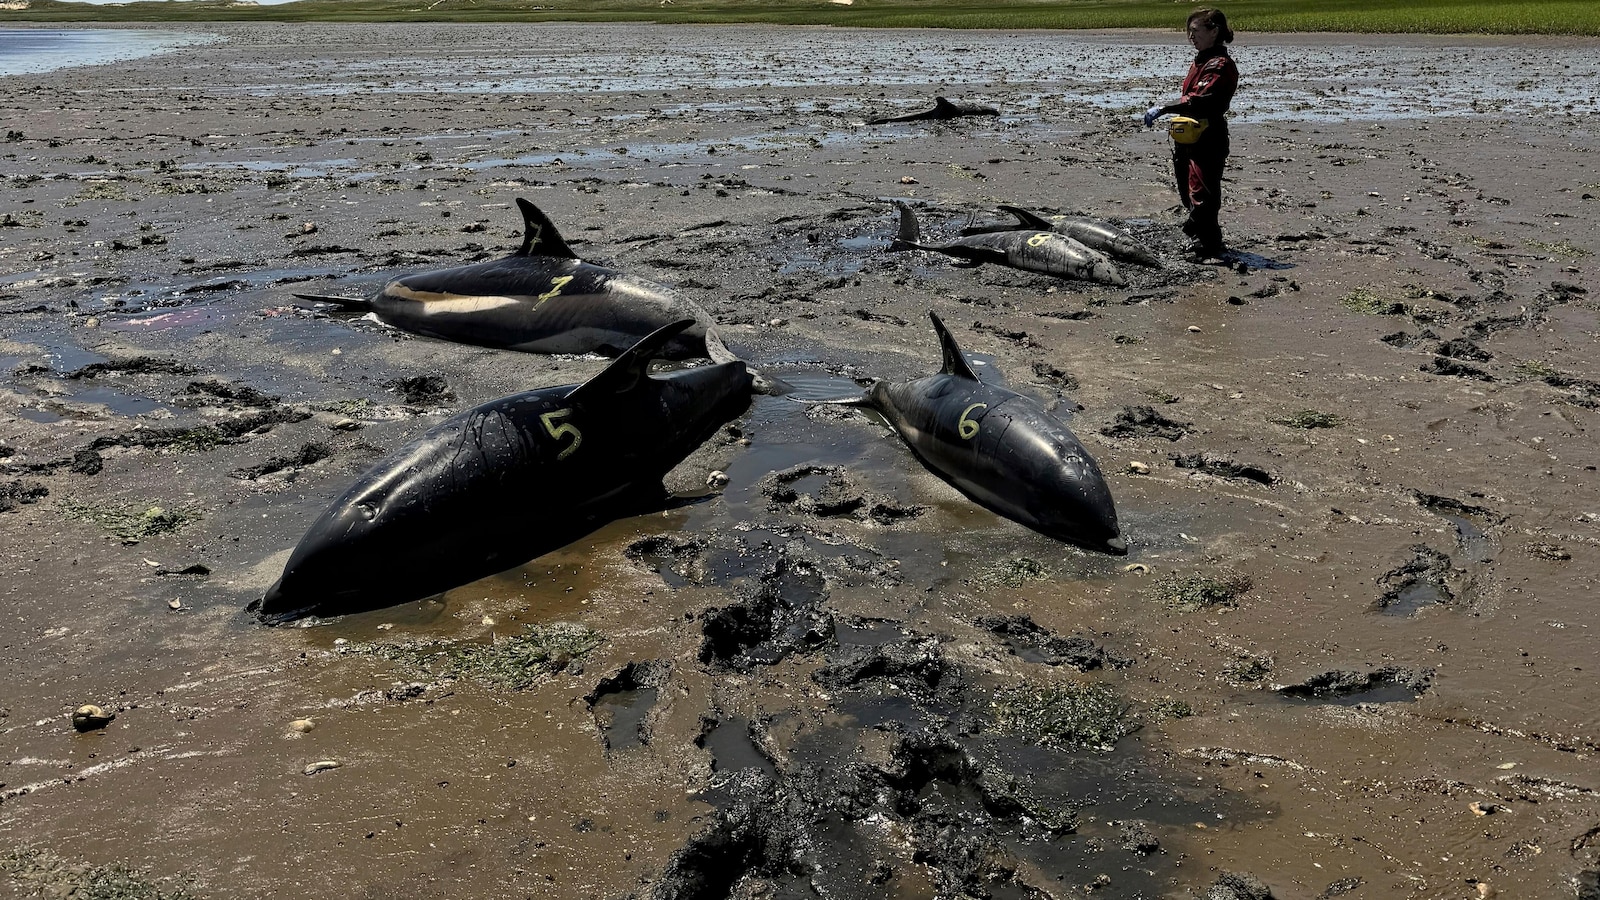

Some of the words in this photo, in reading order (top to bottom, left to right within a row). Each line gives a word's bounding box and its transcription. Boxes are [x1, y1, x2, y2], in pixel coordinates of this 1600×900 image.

[529, 221, 543, 255] 7
[532, 275, 574, 312] 7
[539, 407, 583, 461] 5
[958, 402, 988, 440] 6
